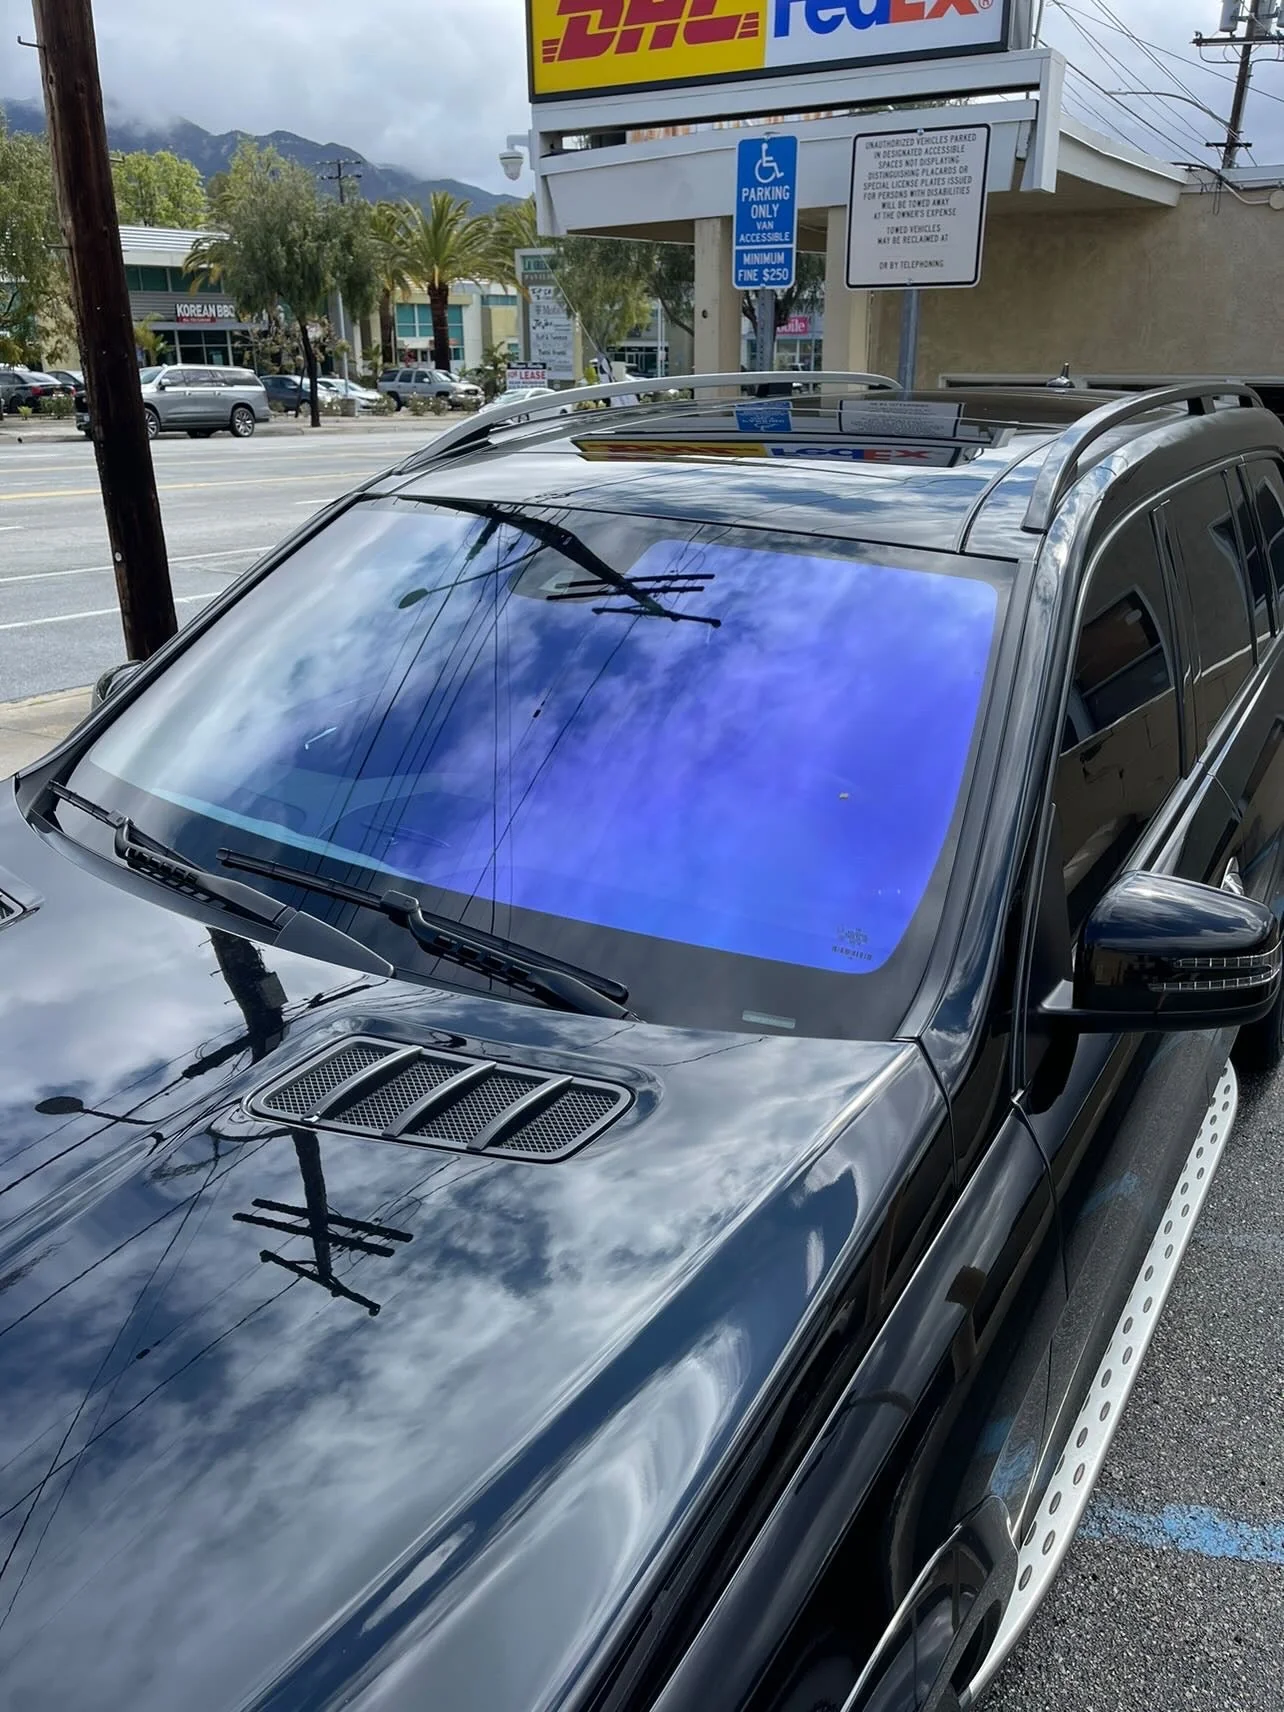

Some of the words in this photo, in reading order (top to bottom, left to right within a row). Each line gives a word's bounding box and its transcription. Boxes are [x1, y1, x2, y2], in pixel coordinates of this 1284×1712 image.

[865, 138, 914, 150] UNAUTHORIZED
[917, 135, 948, 146] VEHICLES
[950, 133, 976, 143] PARKED
[874, 151, 880, 159] IN
[883, 148, 922, 158] DESIGNATED
[924, 144, 965, 155] ACCESSIBLE
[878, 160, 903, 169] SPACES
[905, 158, 918, 168] NOT
[920, 155, 959, 166] DISPLAYING
[868, 169, 920, 180] DISTINGUISHING
[921, 166, 957, 176] PLACARDS
[959, 165, 968, 174] OR
[863, 181, 889, 190] SPECIAL
[892, 179, 918, 189] LICENSE
[920, 177, 945, 187] PLATES
[947, 175, 972, 185] ISSUED
[741, 185, 790, 202] PARKING
[863, 192, 876, 200] FOR
[878, 190, 908, 199] PERSONS
[910, 188, 925, 197] WITH
[927, 186, 970, 196] DISABILITIES
[881, 201, 895, 209] WILL
[898, 200, 906, 209] BE
[908, 199, 931, 208] TOWED
[932, 198, 950, 206] AWAY
[751, 203, 779, 219] ONLY
[873, 211, 881, 219] AT
[882, 210, 894, 219] THE
[896, 208, 925, 218] OWNER'S
[926, 207, 956, 217] EXPENSE
[756, 220, 774, 230] VAN
[887, 225, 908, 234] TOWED
[910, 224, 941, 233] VEHICLES
[739, 231, 790, 243] ACCESSIBLE
[877, 236, 890, 244] MAY
[892, 235, 900, 244] BE
[902, 234, 939, 244] RECLAIMED
[941, 233, 949, 241] AT
[743, 252, 785, 265] MINIMUM
[879, 261, 888, 270] OR
[889, 261, 898, 269] BY
[900, 260, 944, 269] TELEPHONING
[737, 269, 759, 281] FINE
[762, 268, 789, 282] $250
[176, 303, 216, 317] KOREAN
[216, 304, 236, 318] BBQ
[520, 370, 546, 380] LEASE
